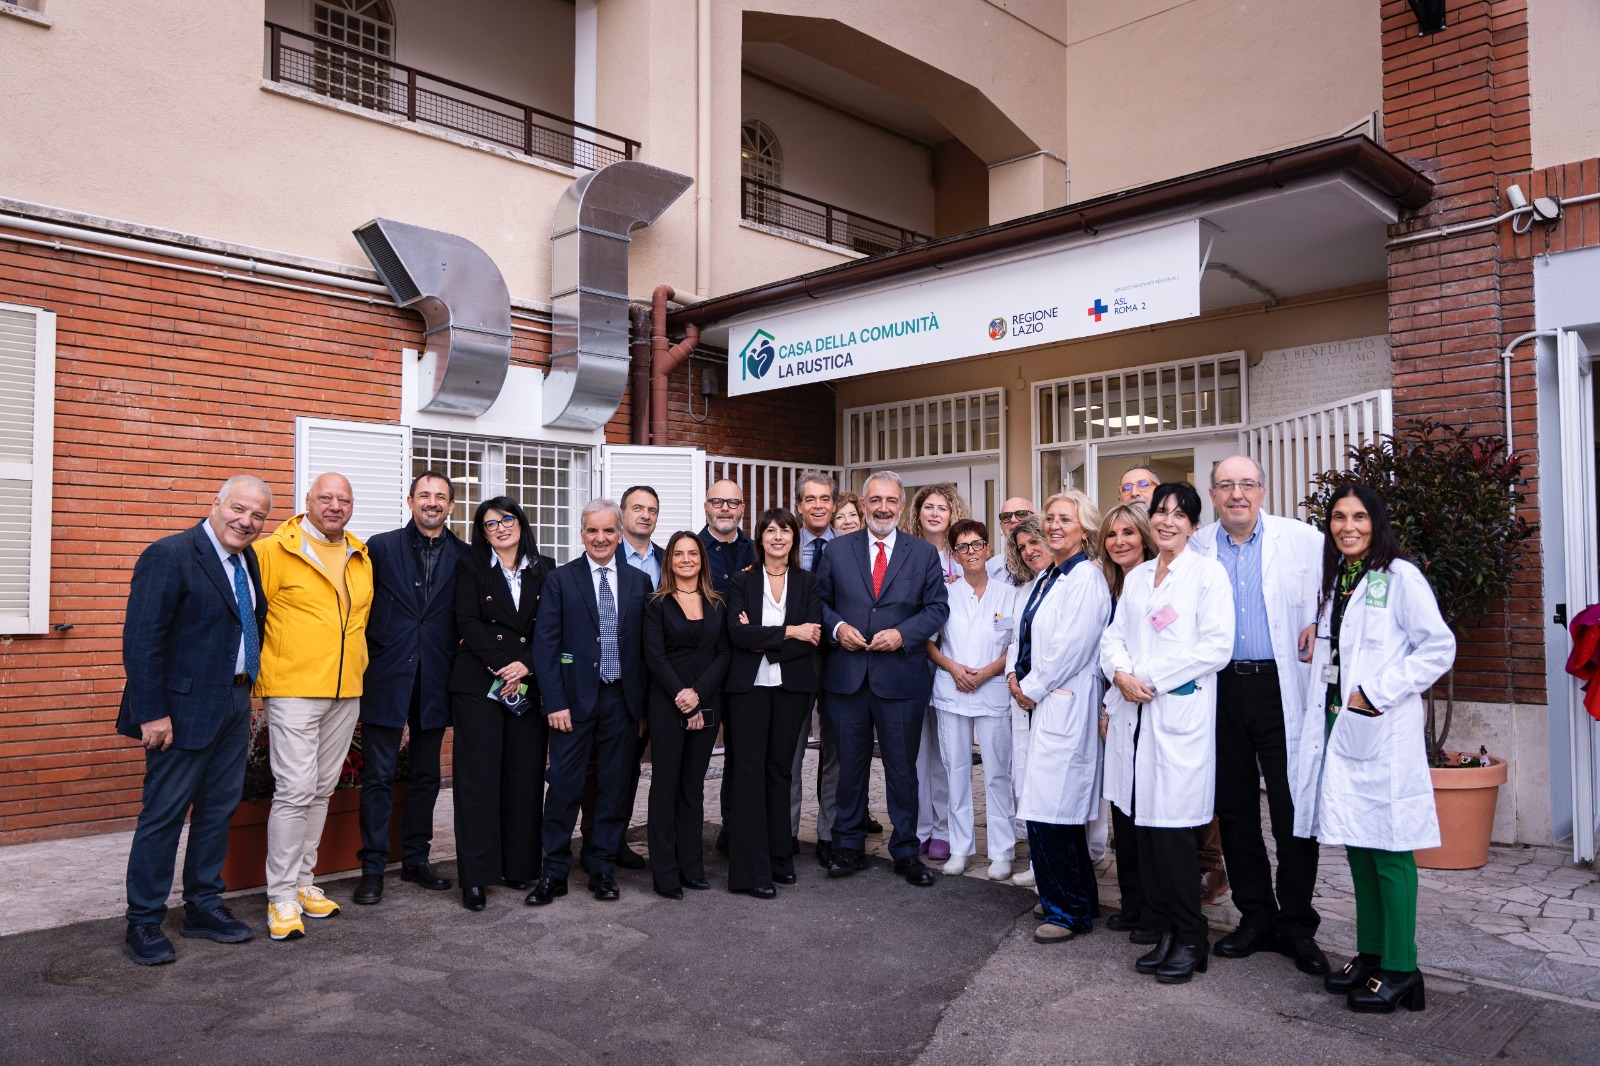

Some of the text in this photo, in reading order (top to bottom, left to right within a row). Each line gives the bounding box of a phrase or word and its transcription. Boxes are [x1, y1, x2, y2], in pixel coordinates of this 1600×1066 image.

[1114, 297, 1127, 306] ASL
[1114, 304, 1138, 315] ROMA
[1012, 307, 1058, 325] REGIONE
[778, 312, 939, 359] CASA DELLA COMUNITÀ
[1012, 322, 1044, 337] LAZIO
[1294, 339, 1375, 357] BENEDETTO
[778, 352, 853, 378] LA RUSTICA
[1250, 358, 1316, 376] ONTEFICE
[1321, 350, 1376, 366] OTTIMO
